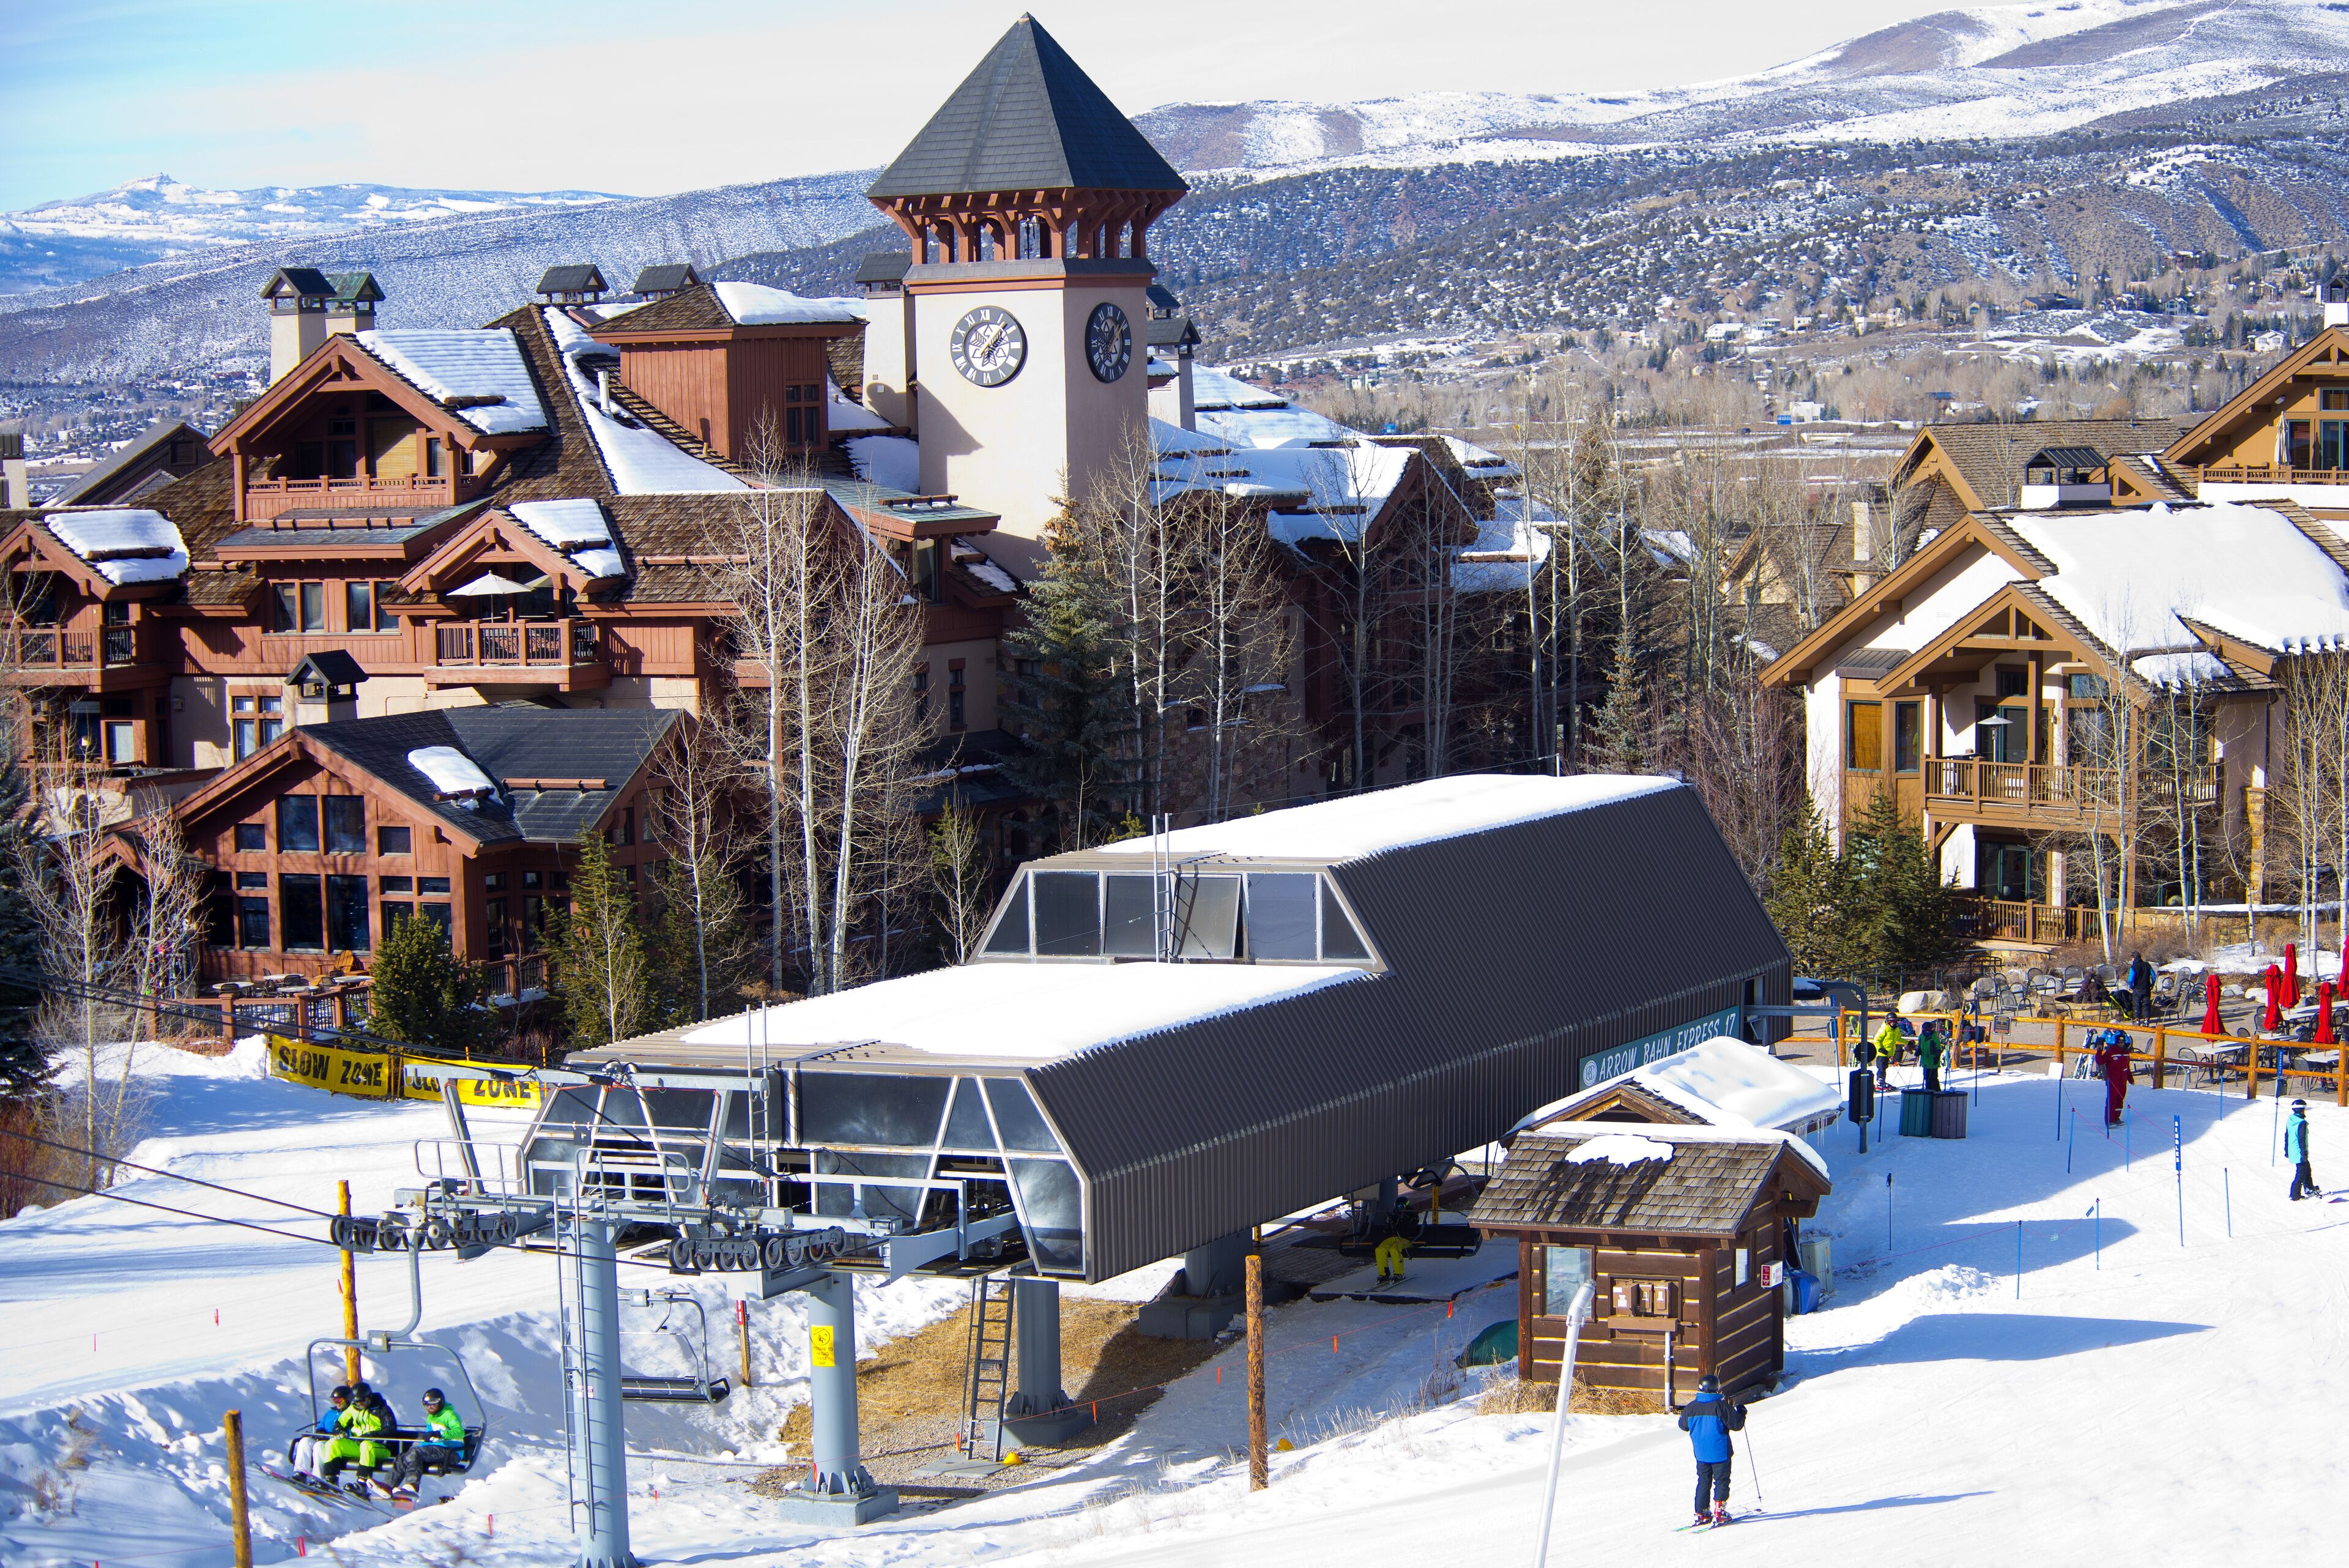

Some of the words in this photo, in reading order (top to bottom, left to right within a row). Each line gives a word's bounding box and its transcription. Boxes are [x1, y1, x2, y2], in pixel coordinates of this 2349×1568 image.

[980, 309, 990, 321] XII
[1598, 1047, 1638, 1082] ARROW
[1643, 1035, 1671, 1065] BAHN
[1677, 1018, 1720, 1053] EXPRESS
[1725, 1013, 1737, 1037] 17
[278, 1045, 330, 1080] SLOW
[340, 1060, 383, 1087] ZONE
[474, 1079, 531, 1099] ZONE
